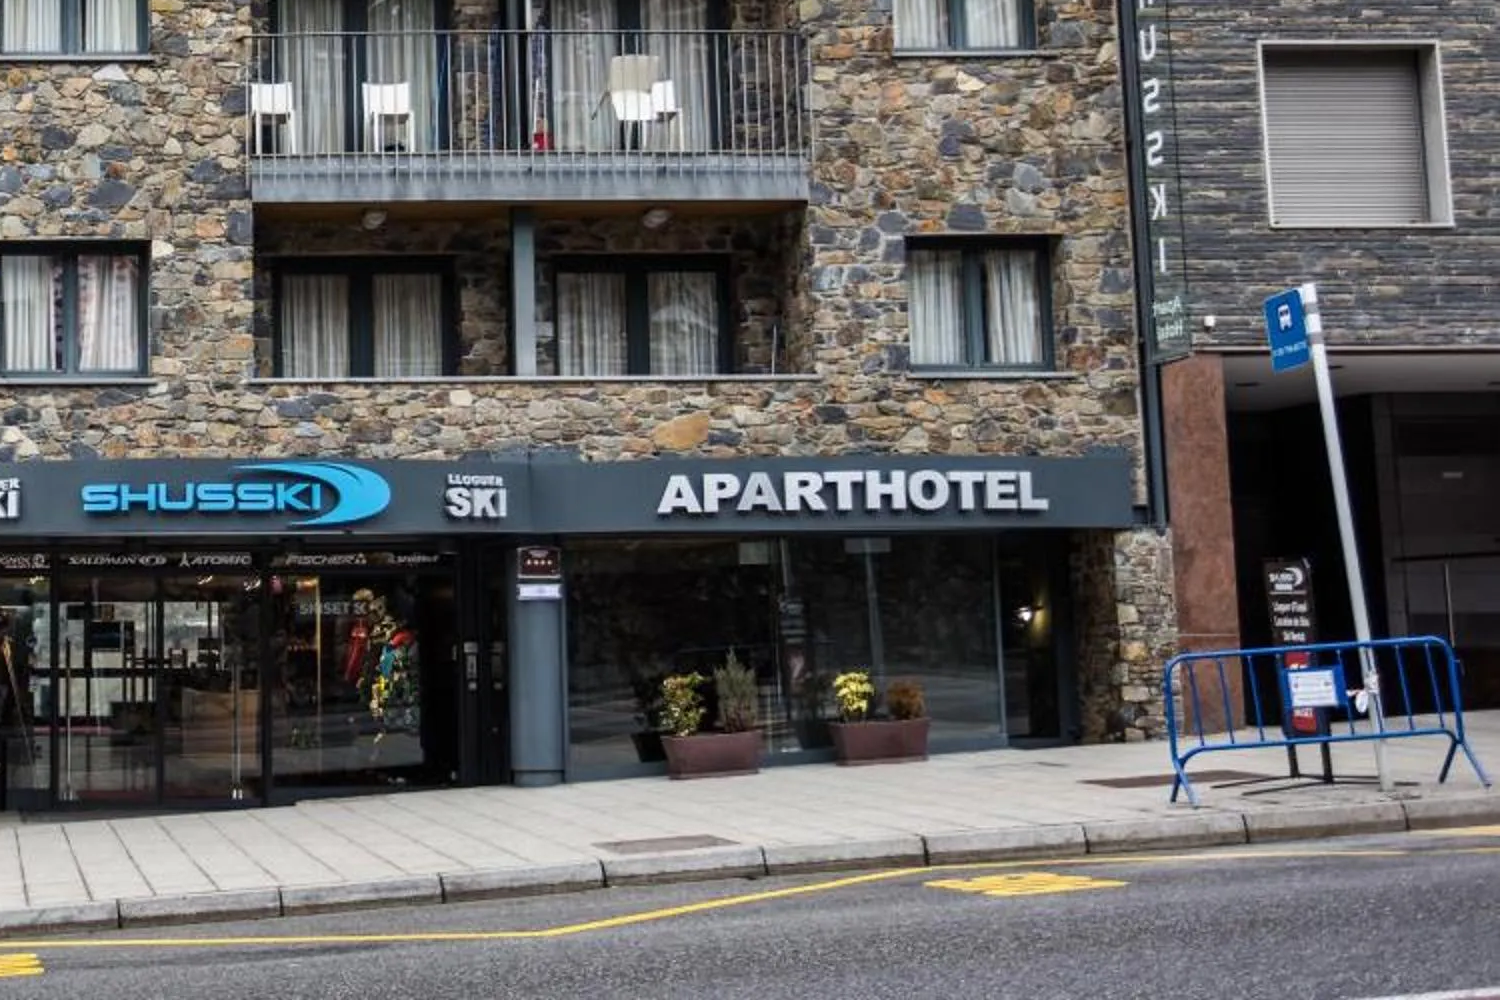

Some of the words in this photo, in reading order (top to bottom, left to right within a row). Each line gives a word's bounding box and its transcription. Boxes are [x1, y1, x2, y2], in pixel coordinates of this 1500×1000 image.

[447, 473, 503, 486] LLOGUER
[657, 470, 1049, 513] APARTHOTEL
[82, 483, 321, 511] SHUSSKI
[444, 487, 507, 517] SKI
